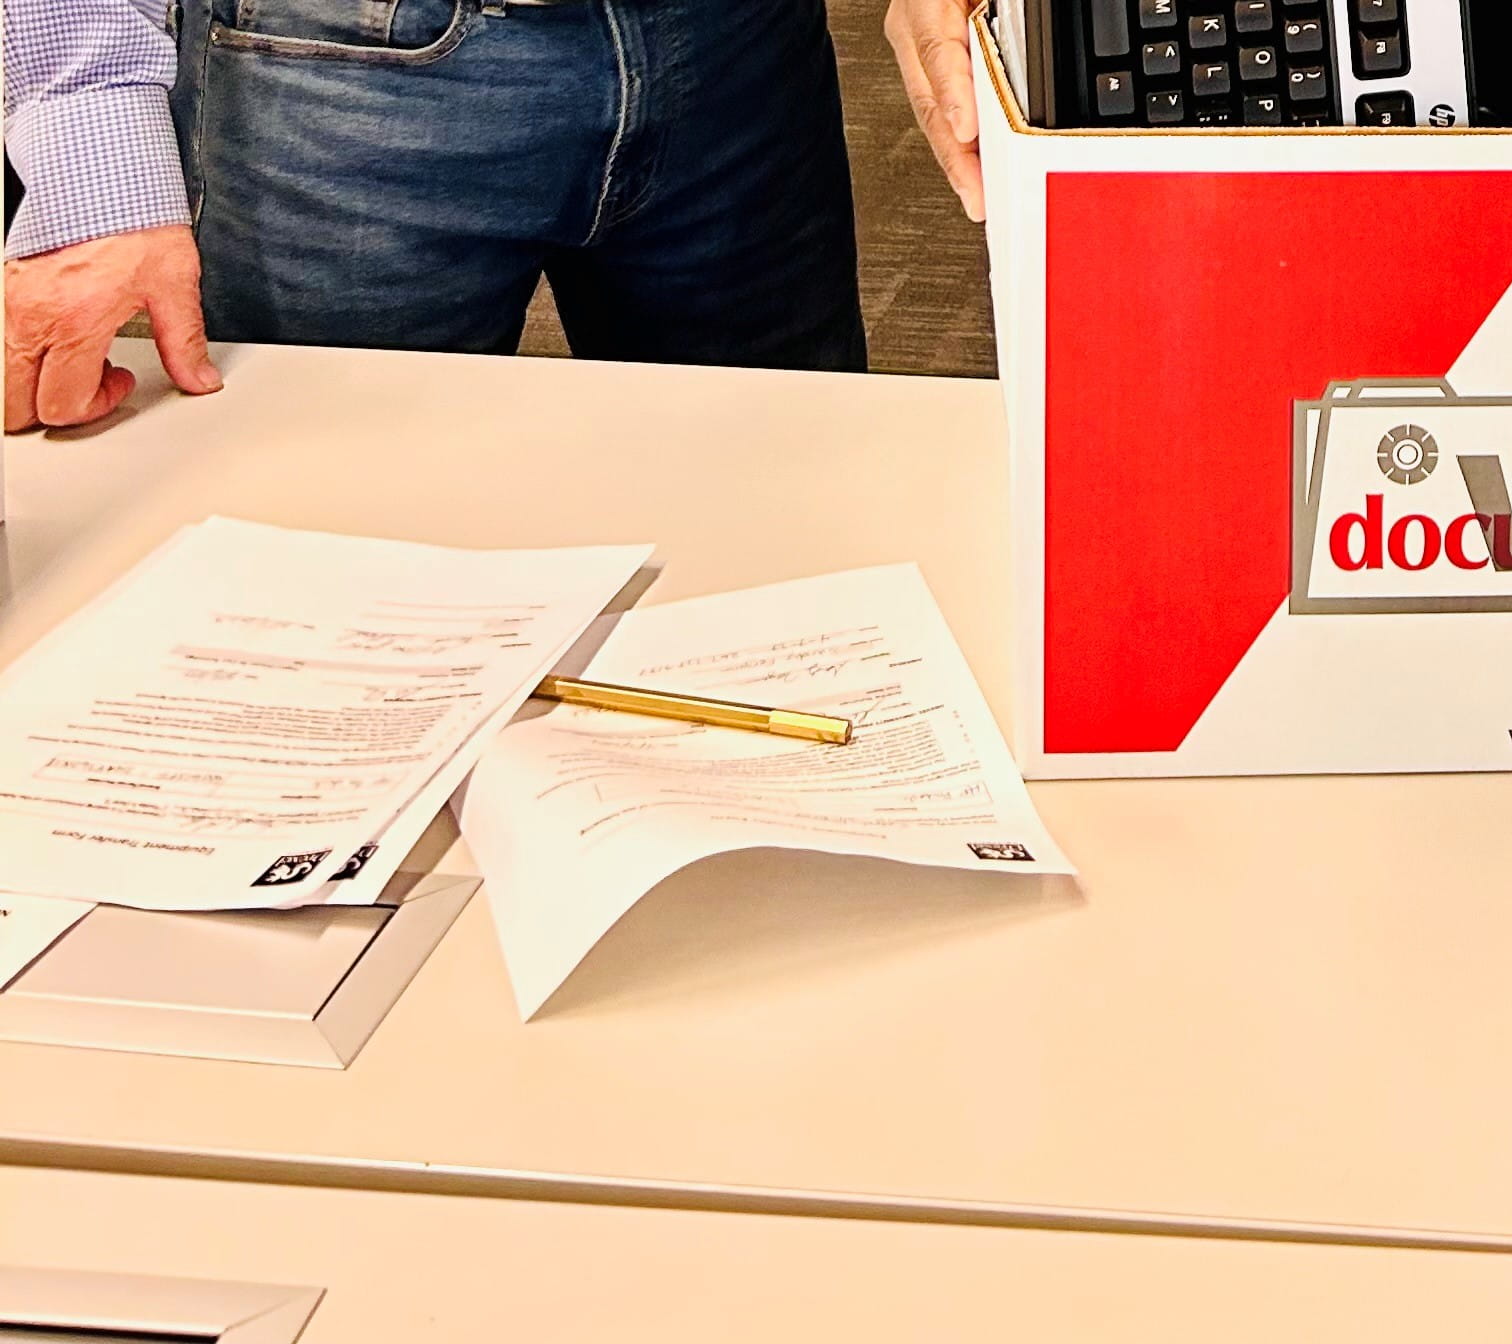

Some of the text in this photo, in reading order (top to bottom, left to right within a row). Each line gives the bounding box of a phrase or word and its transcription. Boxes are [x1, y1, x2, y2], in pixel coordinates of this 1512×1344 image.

[1156, 0, 1170, 13] M
[1204, 19, 1219, 31] K
[1287, 26, 1299, 34] 9
[1256, 51, 1270, 64] O
[1208, 67, 1222, 77] L
[1259, 100, 1273, 110] P
[1382, 113, 1391, 124] F9
[52, 828, 216, 856] Equipment Transfer Form
